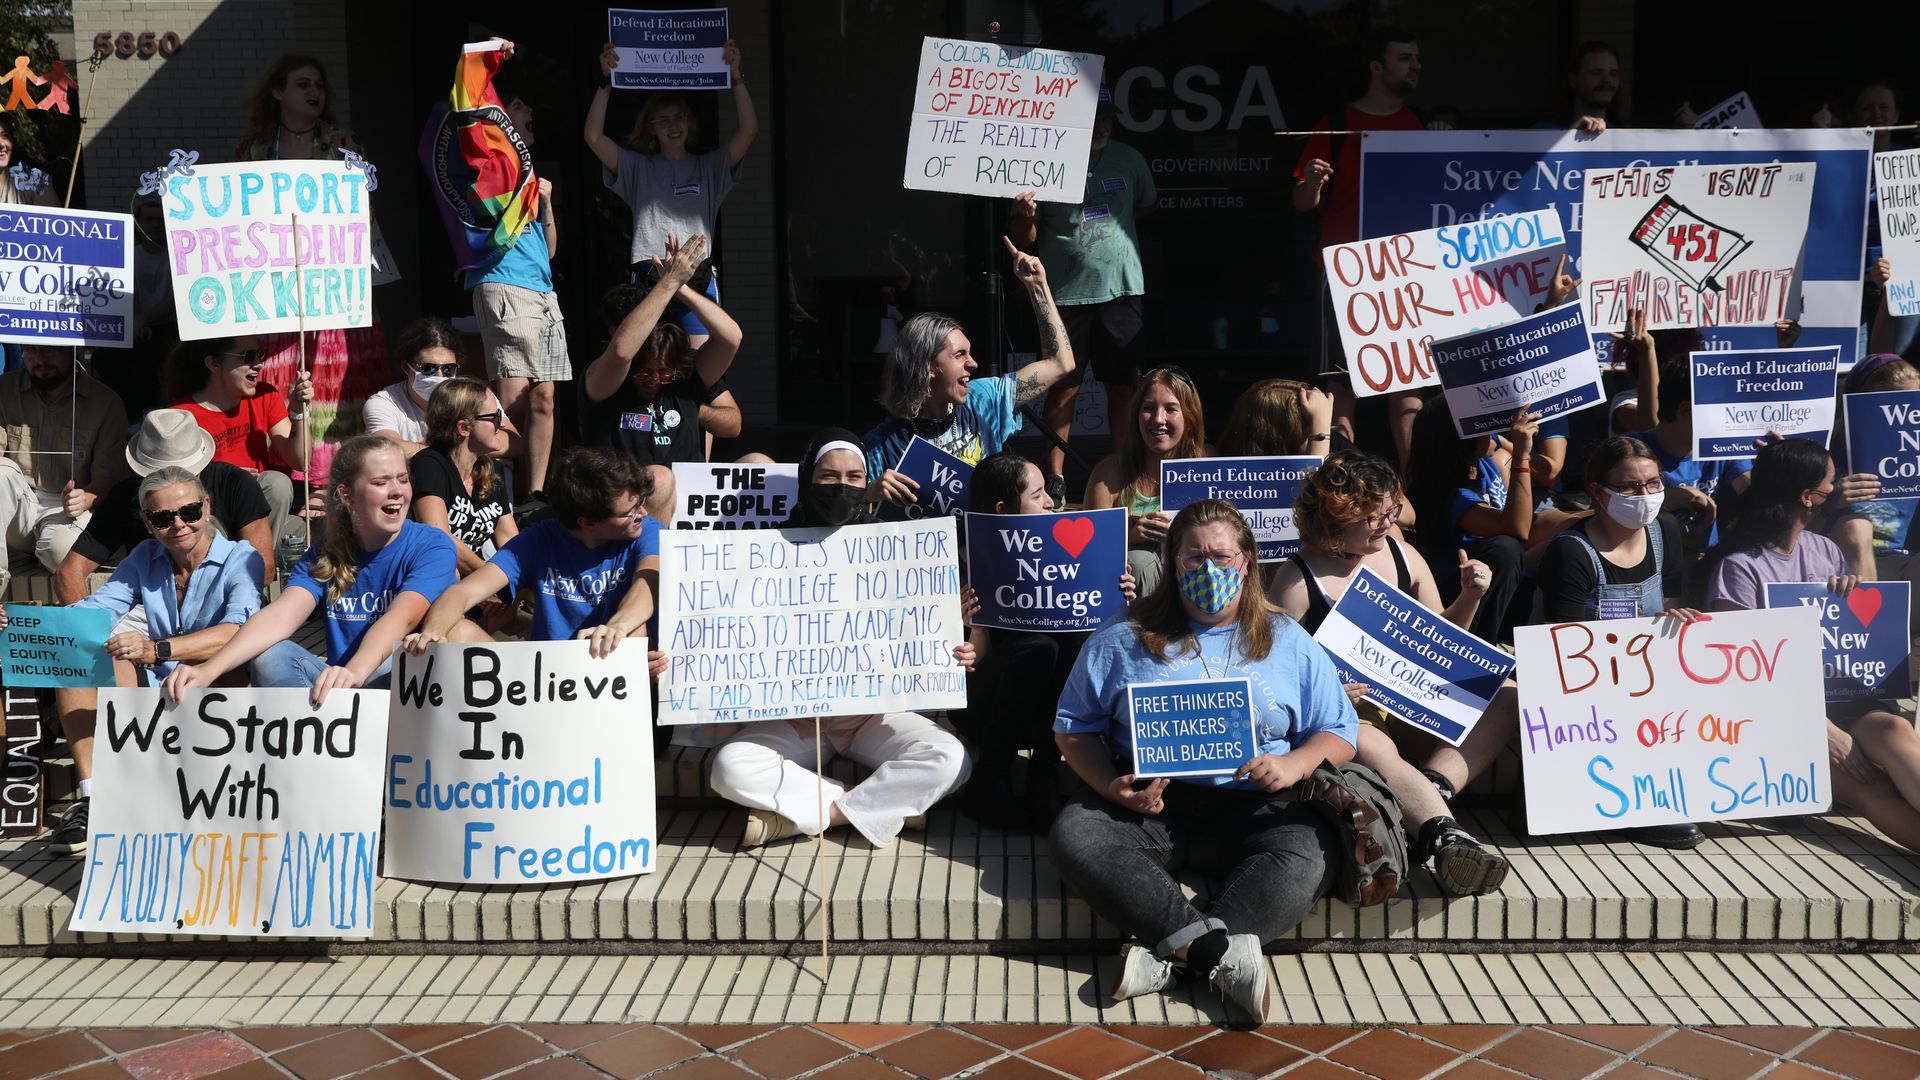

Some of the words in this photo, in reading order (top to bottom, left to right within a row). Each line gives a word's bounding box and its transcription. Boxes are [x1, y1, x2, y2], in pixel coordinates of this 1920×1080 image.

[613, 16, 654, 28] Defend
[658, 17, 725, 29] Educational
[644, 31, 695, 41] Freedom
[94, 31, 182, 57] 5850
[635, 50, 660, 63] New
[663, 50, 705, 68] College
[625, 76, 714, 85] SaveNewCollege.org/Join
[928, 67, 942, 87] A
[949, 67, 1022, 93] BIGOT'S
[1035, 76, 1078, 98] WAY
[931, 93, 963, 112] OF
[968, 94, 1055, 120] DENYING
[1102, 65, 1288, 132] CSA
[928, 120, 969, 144] THE
[980, 123, 1067, 150] REALITY
[924, 156, 957, 178] OF
[976, 156, 1065, 190] RACISM
[1151, 157, 1272, 173] GOVERNMENT
[1443, 160, 1522, 191] Save
[1532, 160, 1585, 191] Ne
[167, 171, 365, 221] SUPPORT
[1591, 168, 1674, 198] THIS
[1707, 165, 1782, 198] ISNT
[1180, 196, 1244, 209] MATTERS
[170, 222, 367, 276] PRESIDENT
[1333, 234, 1436, 287] OUR
[1437, 214, 1562, 269] SCHOOL
[1667, 224, 1720, 263] 451
[19, 265, 125, 308] College
[188, 267, 366, 325] OKKER!!
[1346, 282, 1454, 336] OUR
[1452, 256, 1550, 315] HOME
[29, 299, 42, 311] of
[47, 299, 91, 313] Florida
[1437, 340, 1491, 364] Defend
[1494, 312, 1583, 351] Educational
[1480, 345, 1550, 372] Freedom
[1696, 361, 1751, 377] Defend
[1756, 357, 1836, 375] Educational
[1476, 382, 1509, 403] New
[1513, 366, 1567, 394] College
[1736, 379, 1804, 394] Freedom
[1725, 406, 1757, 424] New
[1761, 404, 1811, 425] College
[1879, 404, 1920, 426] We
[711, 468, 766, 489] THE
[930, 459, 964, 494] We
[1166, 470, 1222, 484] Defend
[687, 495, 787, 516] PEOPLE
[1207, 486, 1278, 499] Freedom
[447, 508, 467, 527] UP
[674, 543, 737, 572] THE
[844, 535, 907, 565] VISION
[915, 531, 949, 559] FOR
[998, 529, 1043, 552] We
[1016, 558, 1081, 581] New
[678, 579, 738, 612] NEW
[752, 573, 839, 608] COLLEGE
[856, 571, 887, 602] NO
[896, 564, 958, 600] LONGER
[994, 585, 1102, 616] College
[7, 616, 41, 628] KEEP
[671, 616, 756, 650] ADHERES
[763, 615, 787, 645] TO
[794, 612, 834, 645] THE
[840, 604, 942, 642] ACADEMIC
[998, 615, 1101, 627] SaveNewCollege.org/Join
[1354, 577, 1411, 623] Defend
[1410, 616, 1506, 675] Educational
[8, 633, 78, 648] DIVERSITY,
[1382, 619, 1453, 669] Freedom
[1821, 626, 1870, 650] New
[10, 648, 60, 662] EQUITY,
[889, 640, 951, 668] VALUES
[1353, 634, 1391, 668] New
[1390, 660, 1449, 700] College
[1550, 623, 1654, 698] Big
[11, 664, 88, 678] INCLUSION!
[399, 652, 443, 709] We
[463, 647, 628, 707] Believe
[670, 687, 699, 711] WE
[709, 683, 751, 706] PAID
[758, 680, 783, 706] TO
[792, 674, 857, 701] RECEIVE
[865, 673, 885, 699] IF
[892, 673, 926, 695] OUR
[1134, 695, 1169, 714] FREE
[1171, 690, 1245, 711] THINKERS
[106, 697, 182, 754] We
[192, 692, 360, 759] Stand
[714, 708, 738, 721] ARE
[748, 705, 788, 717] FORCED
[793, 704, 808, 715] TO
[814, 702, 833, 714] GO.
[458, 711, 524, 760] In
[1137, 721, 1170, 739] RISK
[1172, 717, 1226, 736] TAKERS
[1523, 705, 1618, 754] Hands
[1137, 746, 1178, 764] TRAIL
[1181, 741, 1243, 761] BLAZERS
[177, 763, 280, 821] With
[389, 754, 601, 811] Educational
[1586, 755, 1690, 818] Small
[1707, 756, 1820, 814] School
[463, 822, 650, 879] Freedom
